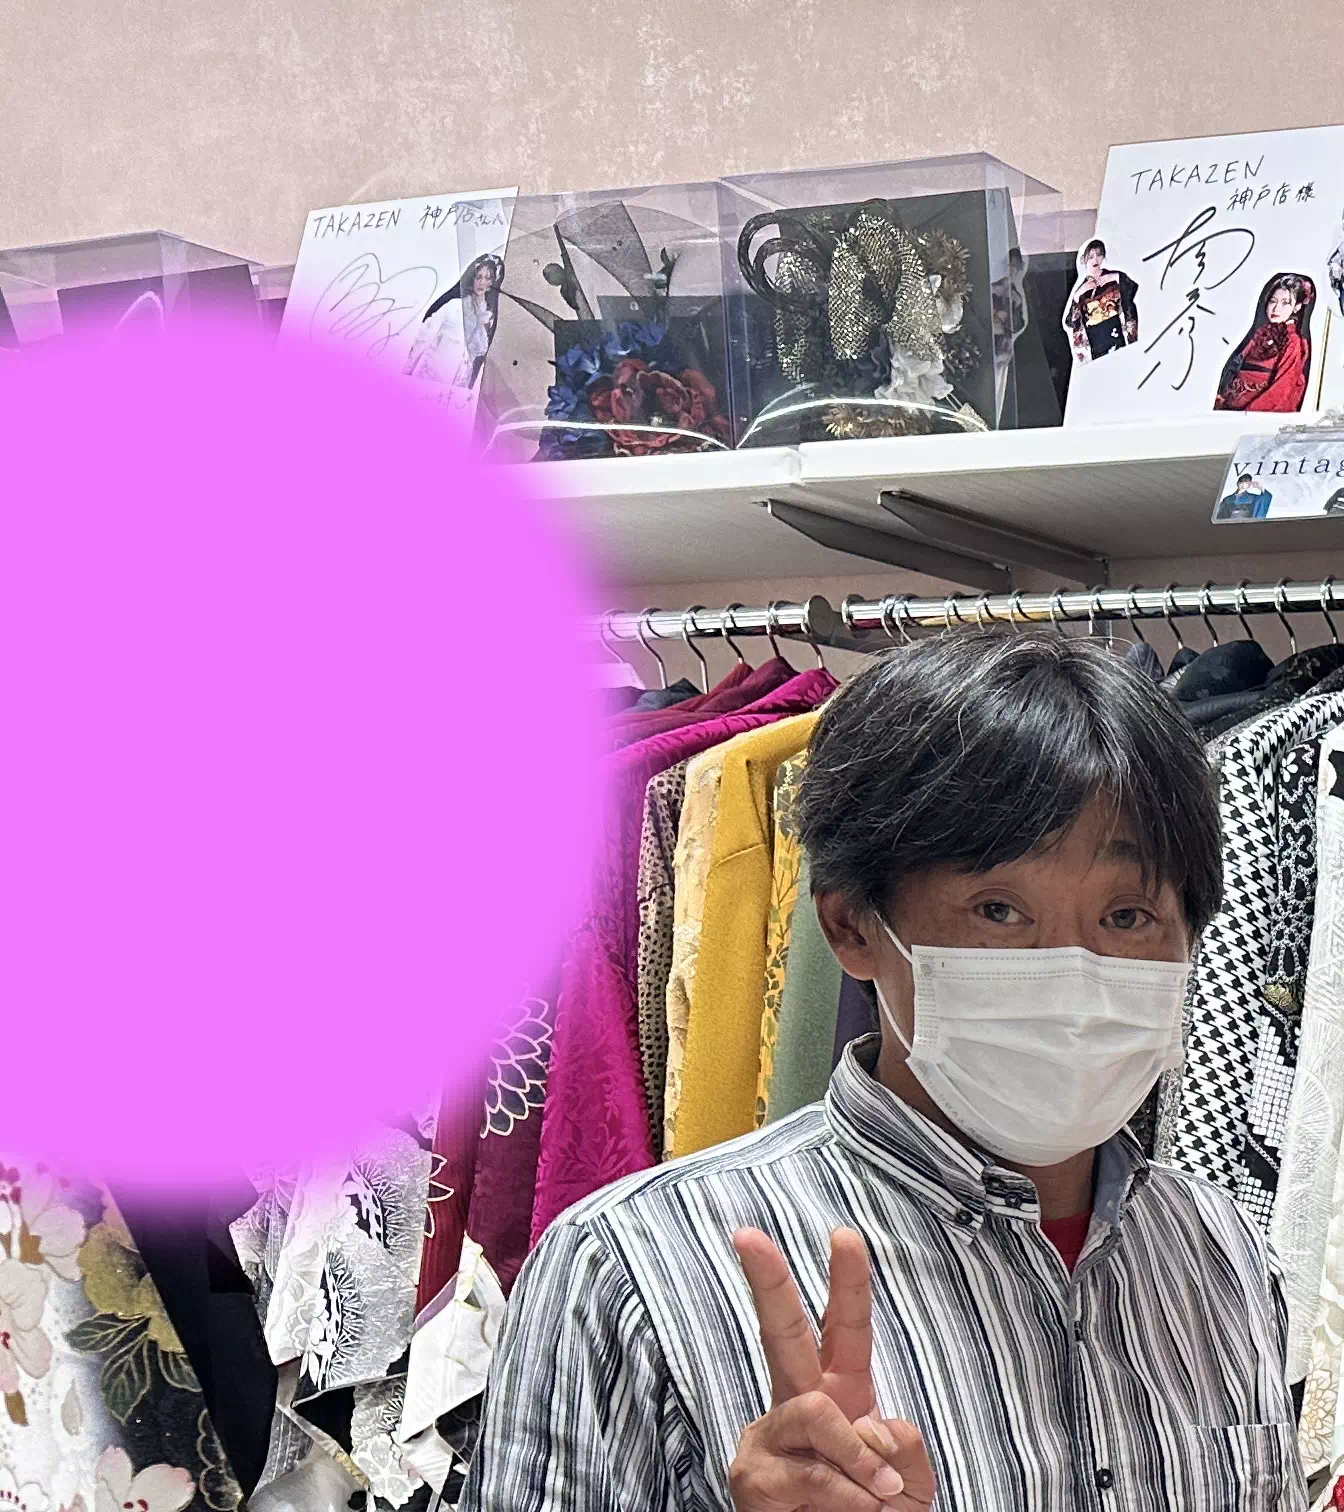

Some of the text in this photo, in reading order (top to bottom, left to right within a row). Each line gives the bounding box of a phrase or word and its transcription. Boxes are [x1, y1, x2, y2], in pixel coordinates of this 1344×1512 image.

[1130, 154, 1265, 196] TAKAZEN
[1227, 181, 1316, 212] 神戸店様
[313, 208, 401, 239] TAKAZEN
